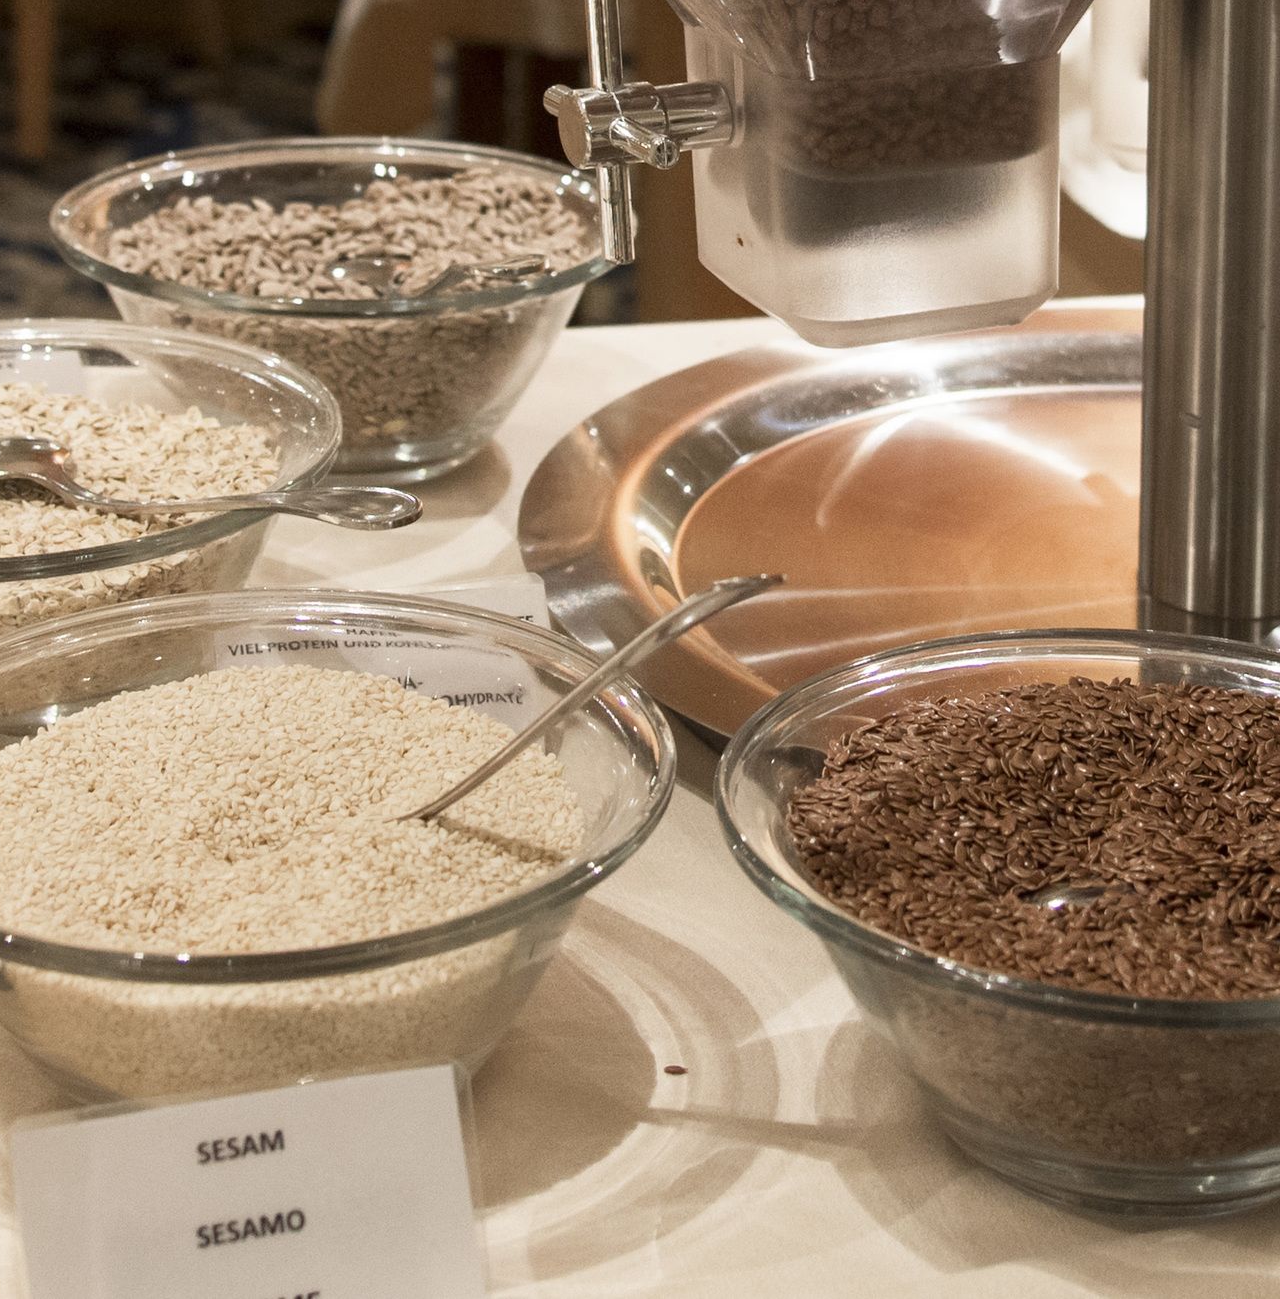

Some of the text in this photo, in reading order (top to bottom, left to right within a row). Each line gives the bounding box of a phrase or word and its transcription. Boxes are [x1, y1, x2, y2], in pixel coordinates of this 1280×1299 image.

[228, 642, 262, 657] VIEL
[267, 639, 338, 654] PROTEIN
[196, 1129, 285, 1165] SESAM
[195, 1208, 306, 1248] SESAMO
